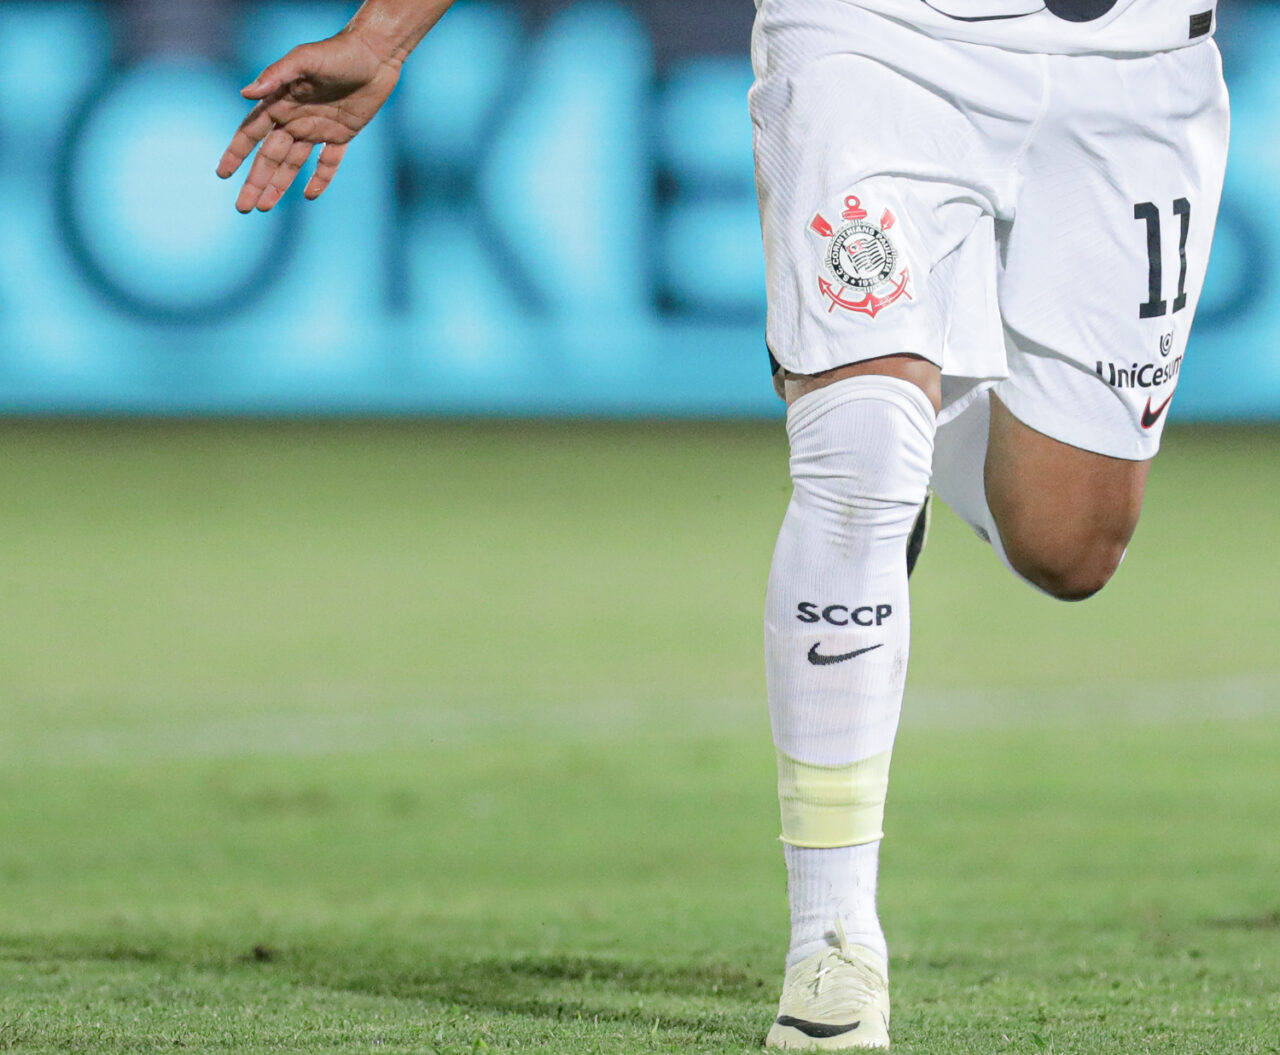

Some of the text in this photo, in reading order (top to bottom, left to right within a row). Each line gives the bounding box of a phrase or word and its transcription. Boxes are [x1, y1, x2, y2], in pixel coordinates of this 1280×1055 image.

[831, 225, 875, 265] CORINTHIANS
[1133, 196, 1191, 319] 11
[796, 601, 893, 626] SCCP
